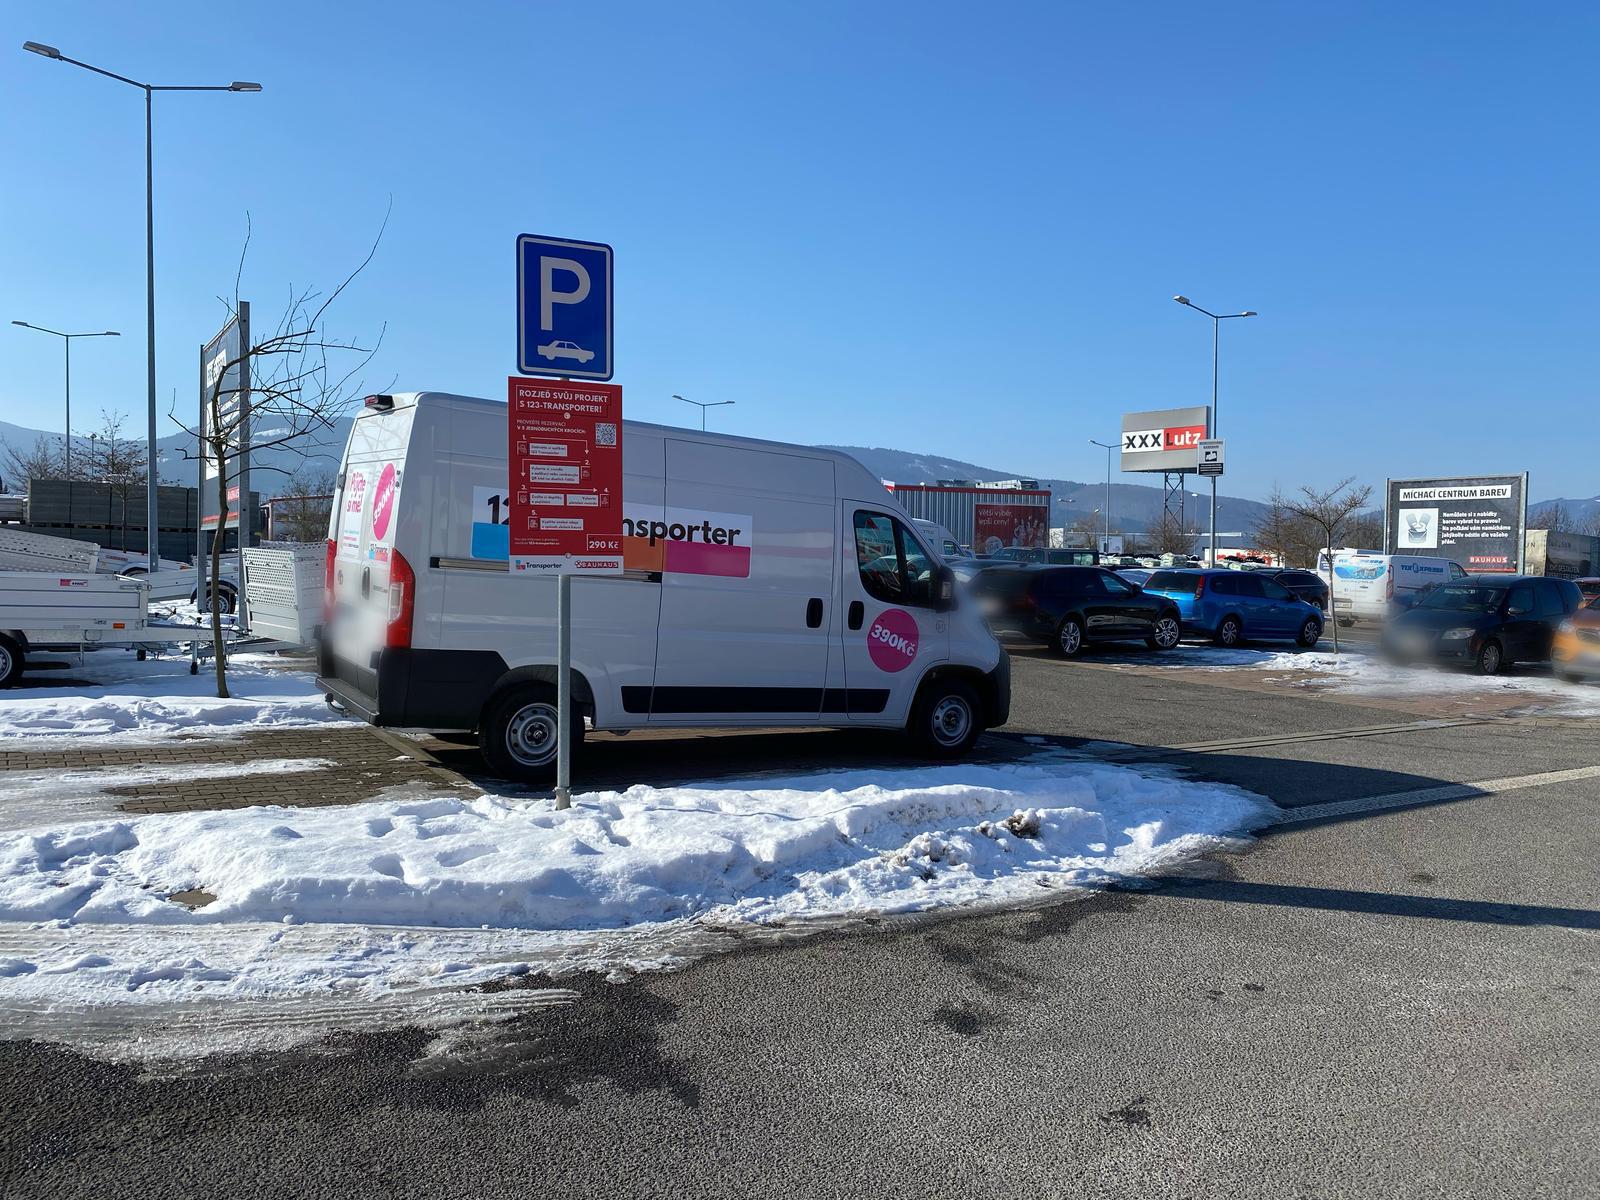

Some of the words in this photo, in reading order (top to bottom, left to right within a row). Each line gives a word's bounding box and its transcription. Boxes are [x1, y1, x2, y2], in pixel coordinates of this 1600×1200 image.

[540, 255, 591, 331] P
[519, 388, 550, 399] ROZJEĎ
[553, 390, 573, 400] SVŮJ
[574, 394, 609, 403] PROJEKT
[519, 400, 525, 408] S
[527, 400, 602, 413] 123-TRANSPORTER!
[1125, 430, 1201, 449] XXXLutz
[1402, 489, 1436, 499] MÍCHACÍ
[1438, 489, 1477, 498] CENTRUM
[1480, 488, 1507, 497] BAREV
[622, 518, 741, 547] nsporter
[589, 541, 606, 549] 290
[608, 540, 619, 549] Kč
[526, 561, 562, 570] Transporter
[871, 624, 916, 657] 390Kč
